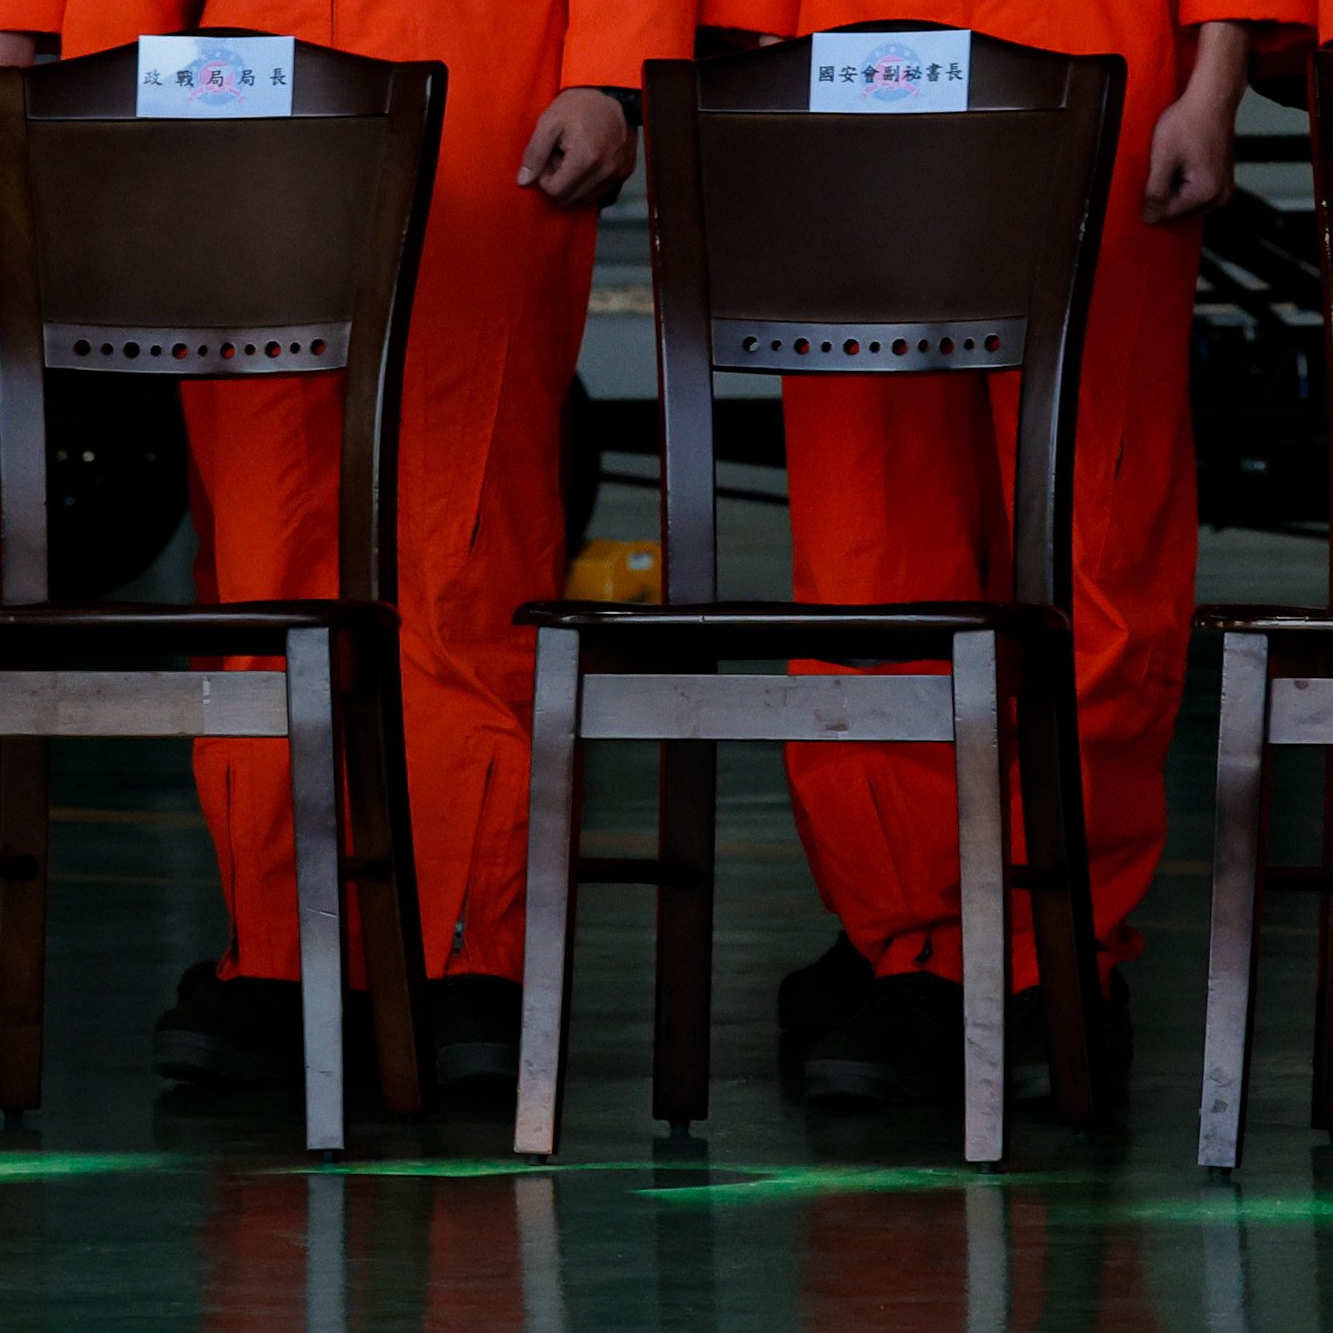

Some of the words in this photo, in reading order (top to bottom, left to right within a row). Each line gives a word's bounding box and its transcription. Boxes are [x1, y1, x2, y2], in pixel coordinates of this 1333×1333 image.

[143, 67, 287, 88] 政戰局局長
